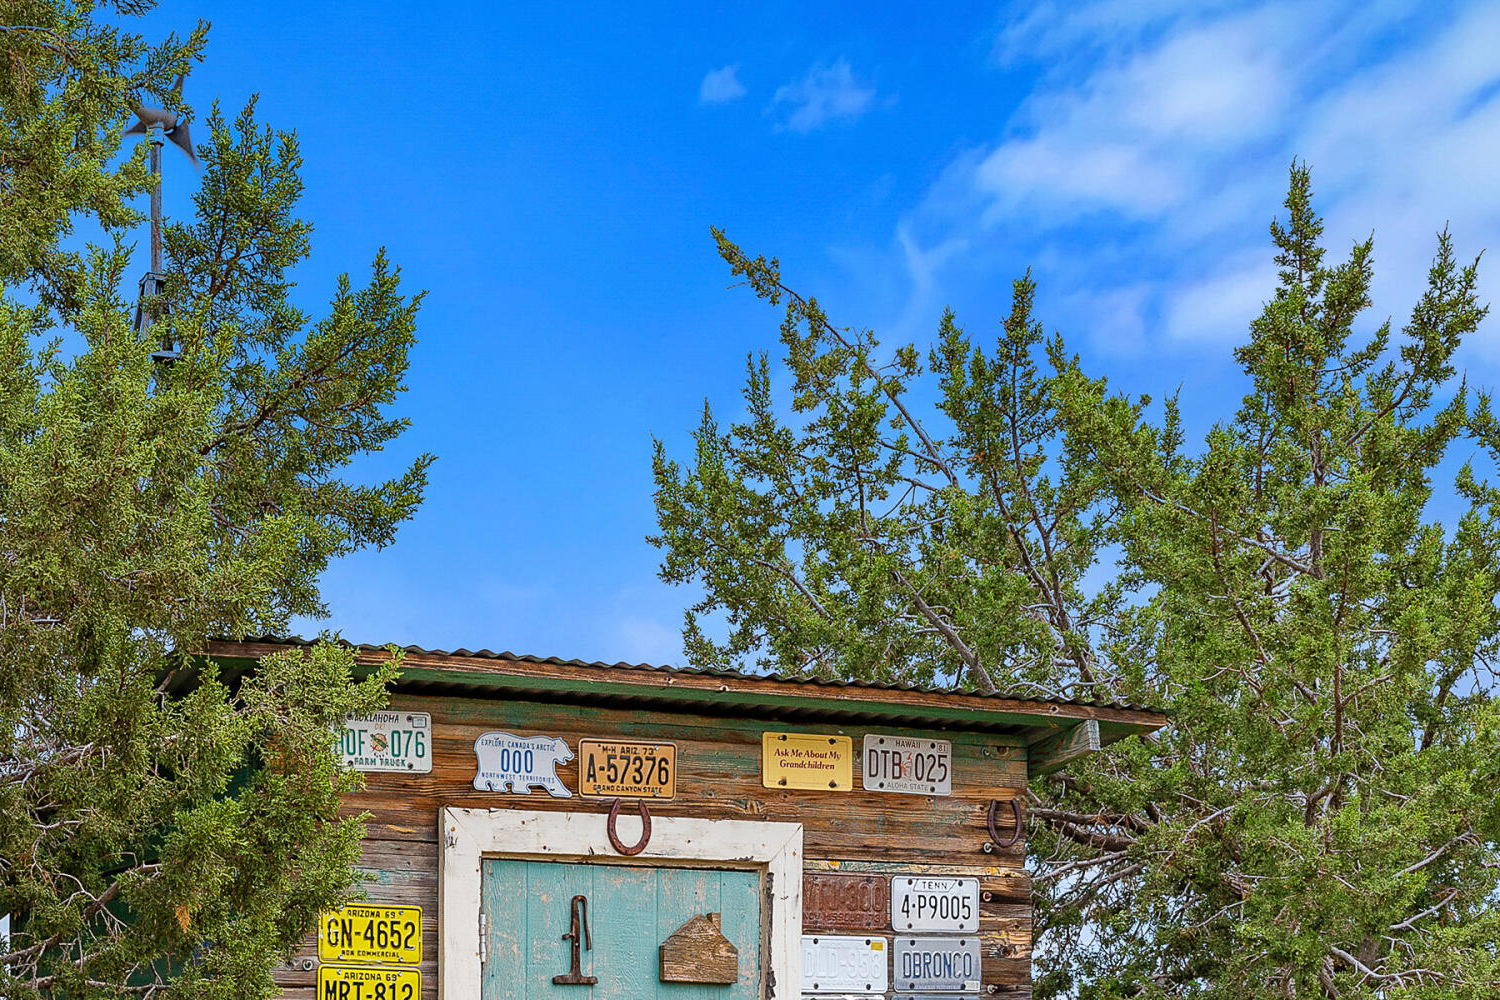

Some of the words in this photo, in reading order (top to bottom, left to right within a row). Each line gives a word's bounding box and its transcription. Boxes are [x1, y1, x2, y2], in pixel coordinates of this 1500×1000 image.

[391, 730, 425, 758] 076
[481, 739, 505, 748] EXPLORE
[507, 741, 535, 750] CANADA'S
[536, 743, 556, 752] ARCTIC
[895, 740, 921, 749] HAWAII
[938, 744, 946, 752] 81
[500, 748, 534, 774] 000
[774, 748, 790, 757] Ask
[791, 748, 803, 758] Me
[804, 750, 828, 759] About
[829, 751, 842, 762] My
[354, 757, 377, 766] FARM
[380, 758, 406, 767] TRUCK
[779, 759, 835, 770] Grandchildren
[868, 749, 902, 780] DTB
[914, 752, 948, 783] 025
[586, 753, 670, 786] A-57376
[481, 772, 516, 780] NORTHWEST
[519, 775, 556, 784] TERRITORIES
[910, 783, 928, 791] STATE
[922, 881, 948, 889] TENN
[347, 910, 381, 918] ARIZONA
[327, 918, 416, 950] GN-4652
[357, 950, 400, 958] COMMERCIAL
[903, 952, 972, 979] DBRONCO
[344, 972, 382, 981] ARIZONA
[386, 973, 397, 981] 69
